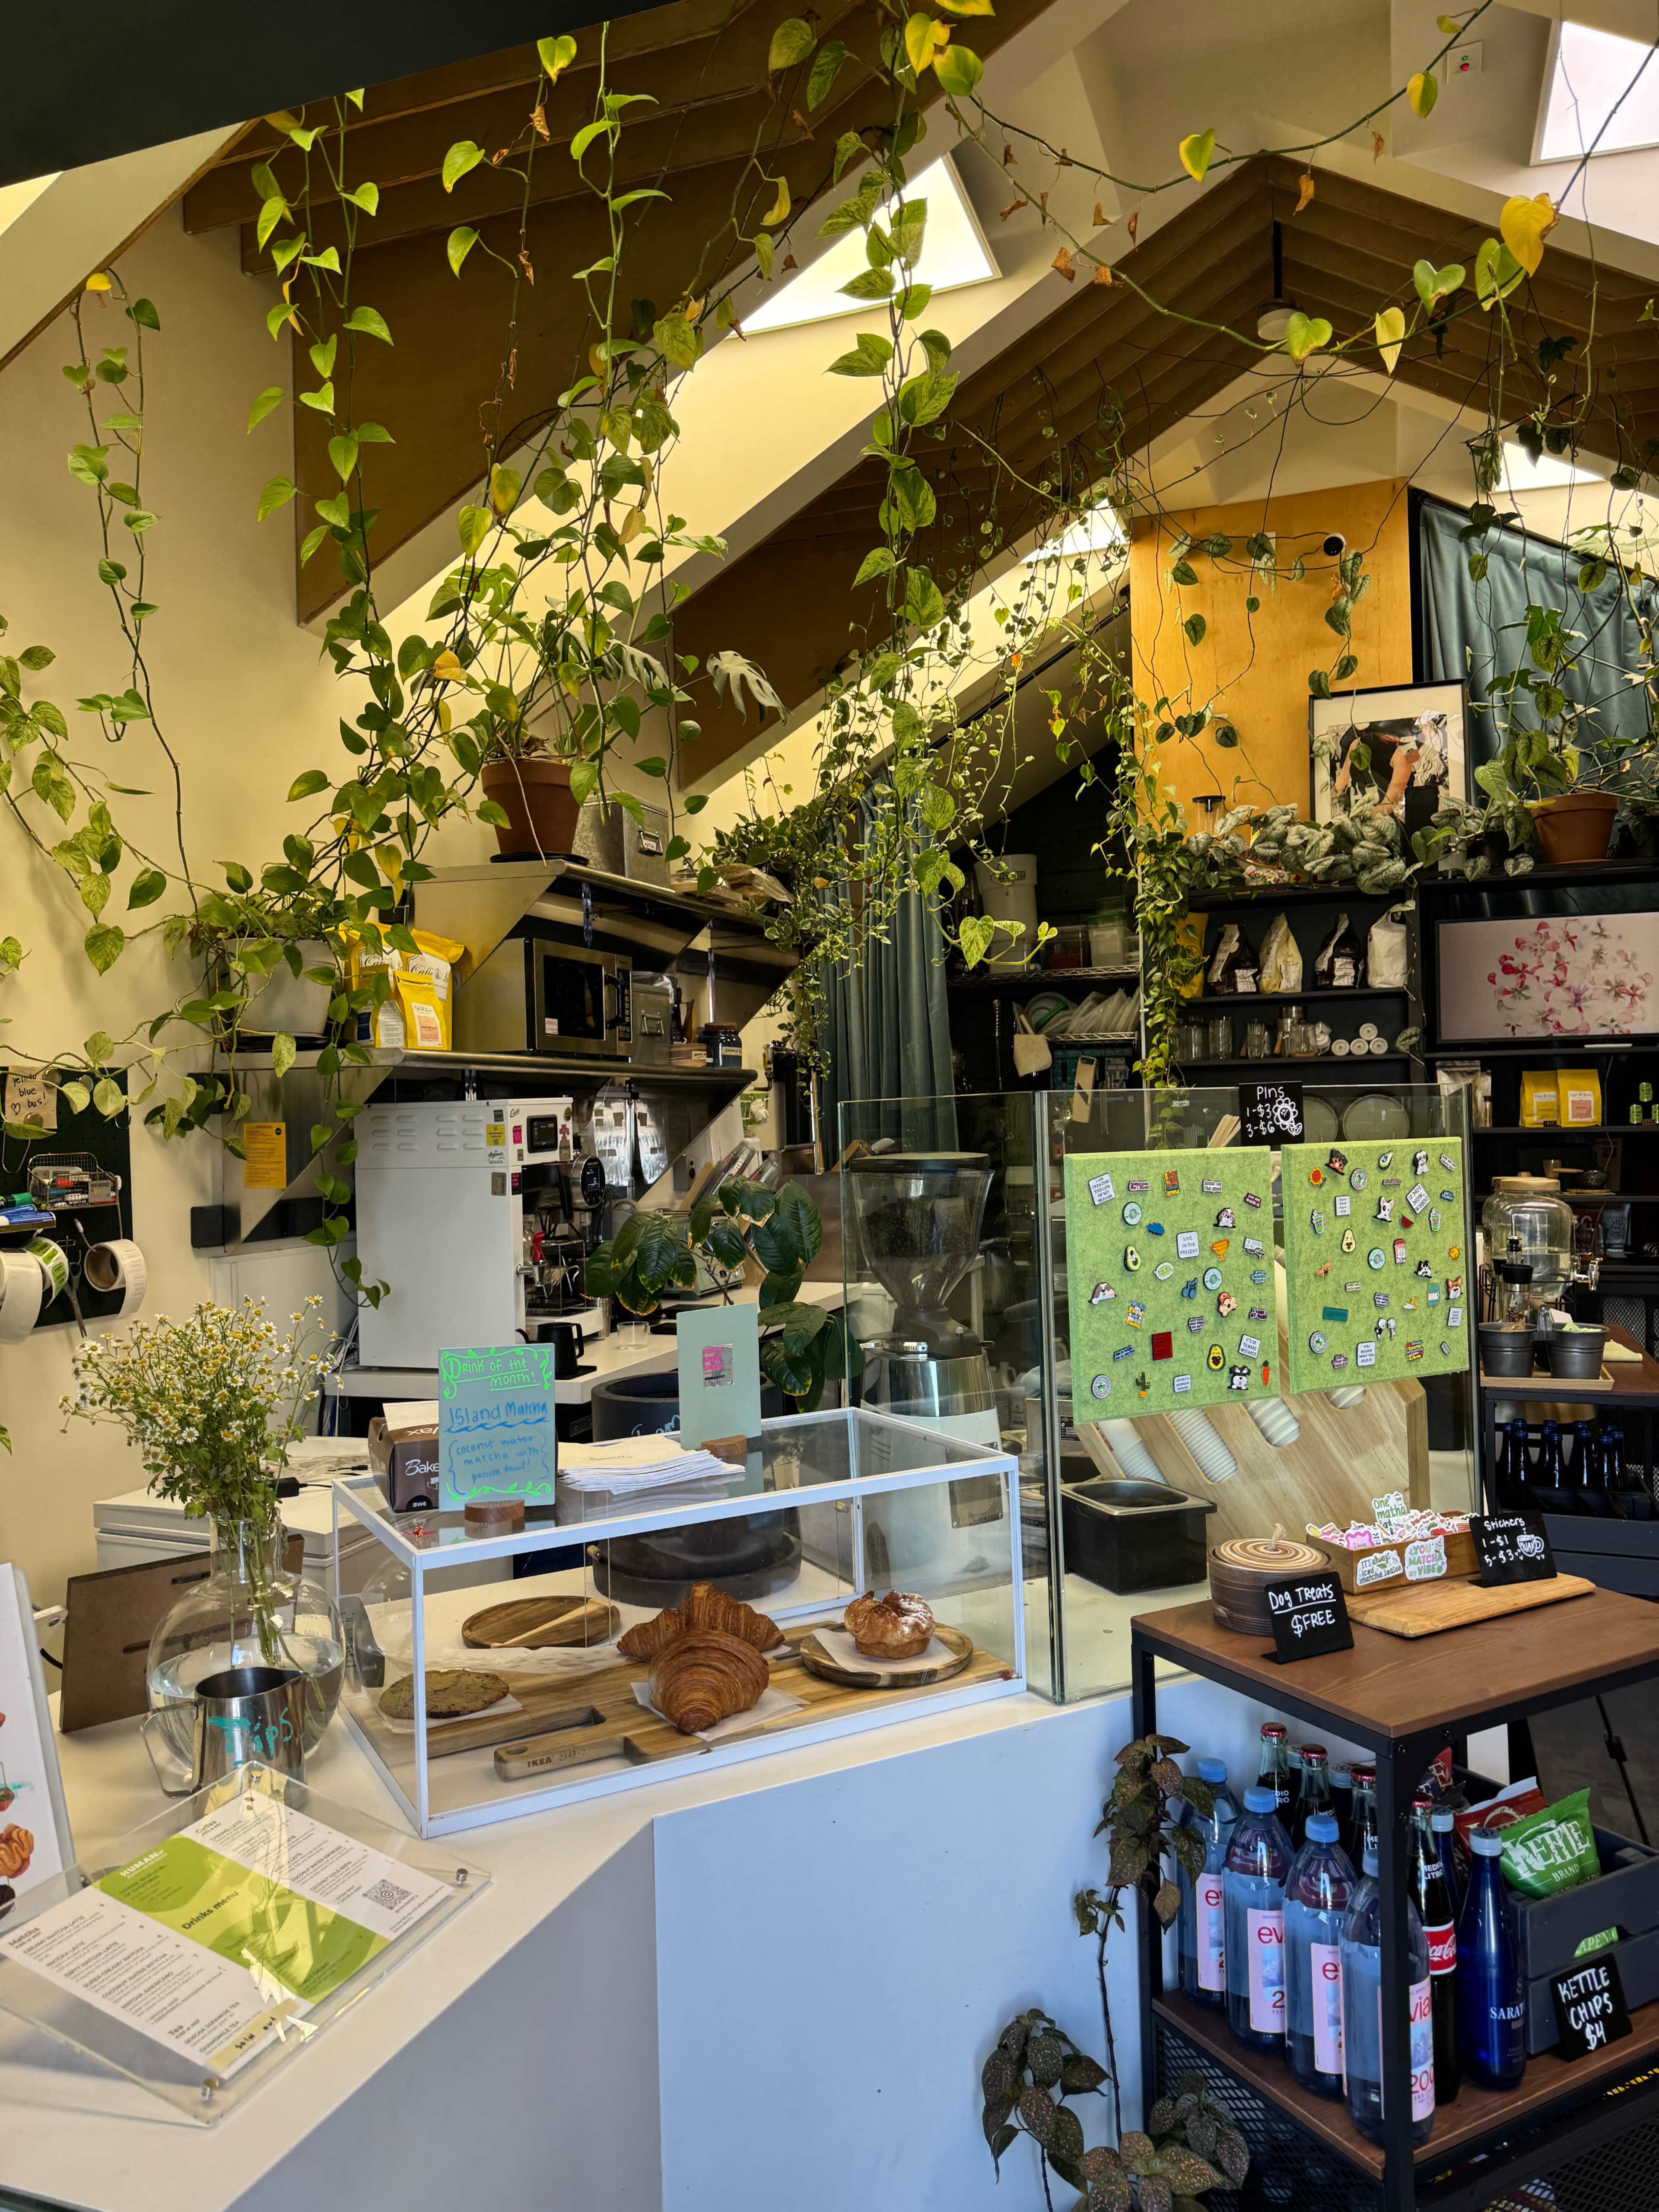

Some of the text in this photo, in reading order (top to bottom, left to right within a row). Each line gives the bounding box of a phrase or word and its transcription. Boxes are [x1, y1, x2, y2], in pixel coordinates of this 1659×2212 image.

[19, 1087, 36, 1097] blue
[27, 1092, 47, 1108] bus!
[1091, 1179, 1110, 1189] CREATING
[1412, 1185, 1422, 1196] NOT
[1415, 1196, 1430, 1212] WHEN?
[1240, 1348, 1256, 1357] MISTAKES
[490, 1359, 502, 1372] of
[509, 1358, 527, 1371] the
[490, 1371, 537, 1387] month!
[504, 1401, 547, 1417] Matcha
[455, 1434, 535, 1456] coconut water
[464, 1445, 540, 1466] matcha with
[471, 1468, 501, 1484] passion
[1373, 1498, 1389, 1509] One
[1412, 1543, 1431, 1555] YOU
[1372, 1553, 1391, 1566] always
[1408, 1552, 1443, 1566] MATCHA
[1360, 1565, 1402, 1585] matcha season
[1361, 1568, 1374, 1577] iced
[1268, 1583, 1334, 1610] Dog Treats
[1291, 1609, 1335, 1638] $FREE
[207, 1707, 293, 1757] Tips
[527, 1757, 554, 1768] IKEA
[194, 1819, 219, 1834] Coffee
[1552, 1863, 1580, 1882] BRAND
[180, 1891, 240, 1930] Drinks menu
[1557, 1967, 1610, 2003] KETTLE
[1570, 1992, 1613, 2030] CHIPS
[1586, 2020, 1607, 2050] $4
